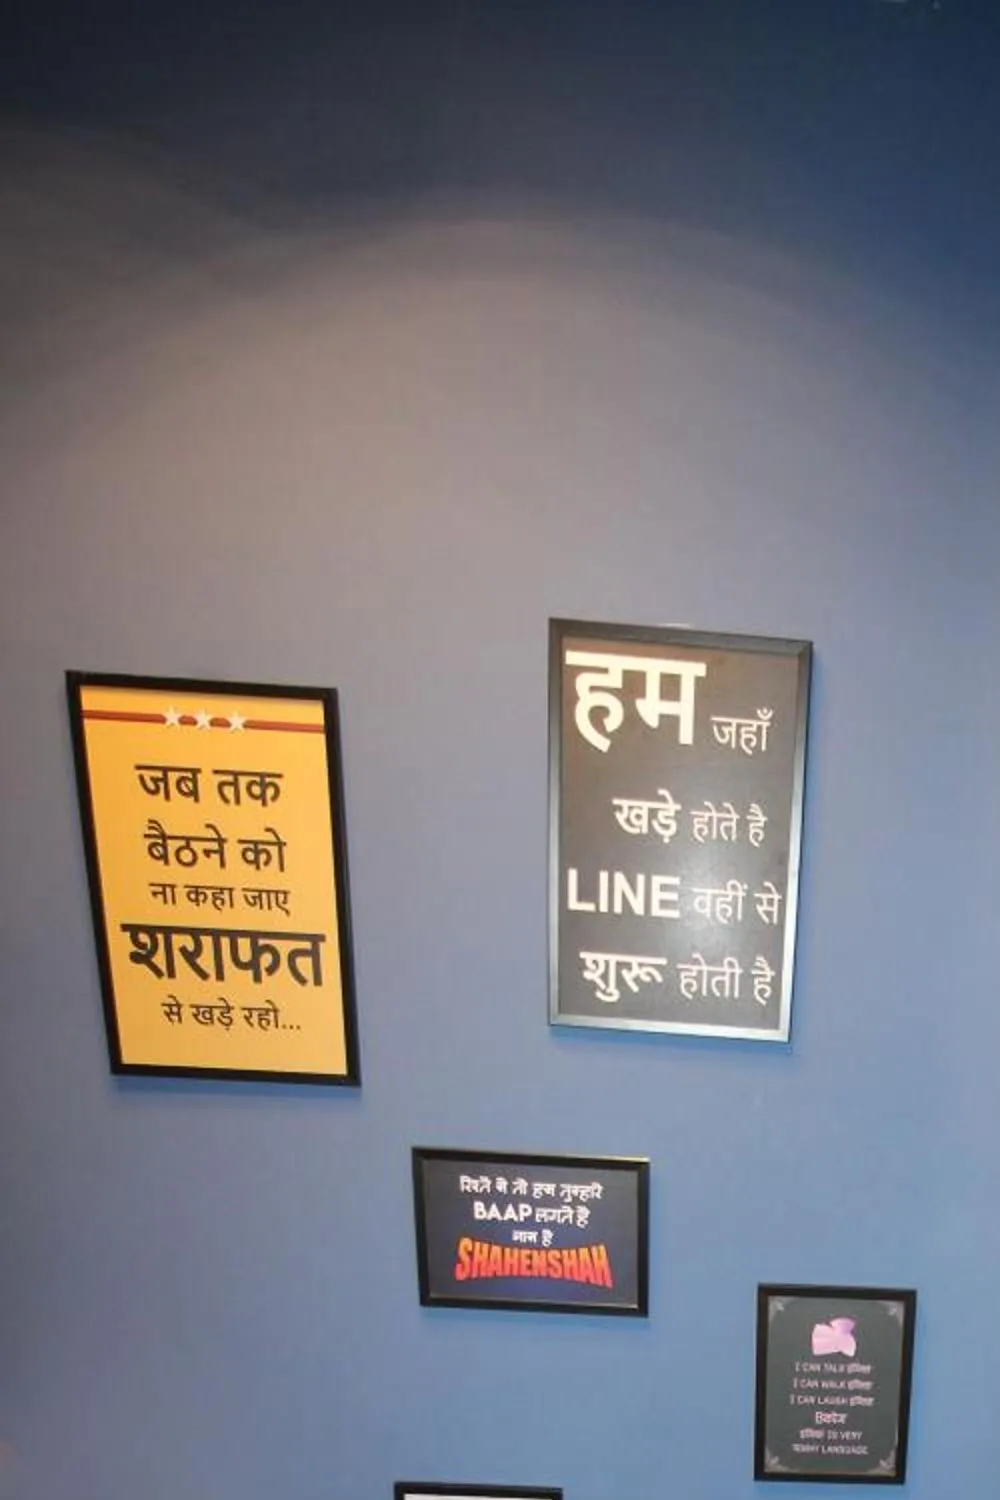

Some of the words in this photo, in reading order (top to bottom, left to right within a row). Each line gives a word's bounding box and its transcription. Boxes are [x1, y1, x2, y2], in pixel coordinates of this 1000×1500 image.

[565, 649, 707, 753] हम
[711, 707, 774, 755] जहाँ
[134, 763, 202, 803] जब
[212, 768, 284, 806] तक
[612, 788, 682, 844] खड़े
[689, 801, 741, 843] होते
[144, 819, 226, 869] बैठने
[238, 827, 287, 873] को
[149, 882, 177, 906] ना
[185, 884, 234, 912] कहा
[242, 887, 291, 917] जाए
[567, 867, 682, 919] LINE
[754, 881, 782, 926] से
[120, 922, 326, 987] शराफत
[579, 951, 668, 1002] शुरू
[677, 952, 743, 1000] होती
[162, 995, 183, 1025] से
[190, 998, 235, 1032] खड़े
[473, 1200, 533, 1222] BAAP
[535, 1205, 575, 1225] लगते
[512, 1177, 528, 1196] तो
[455, 1237, 613, 1290] SHAHENSHAH
